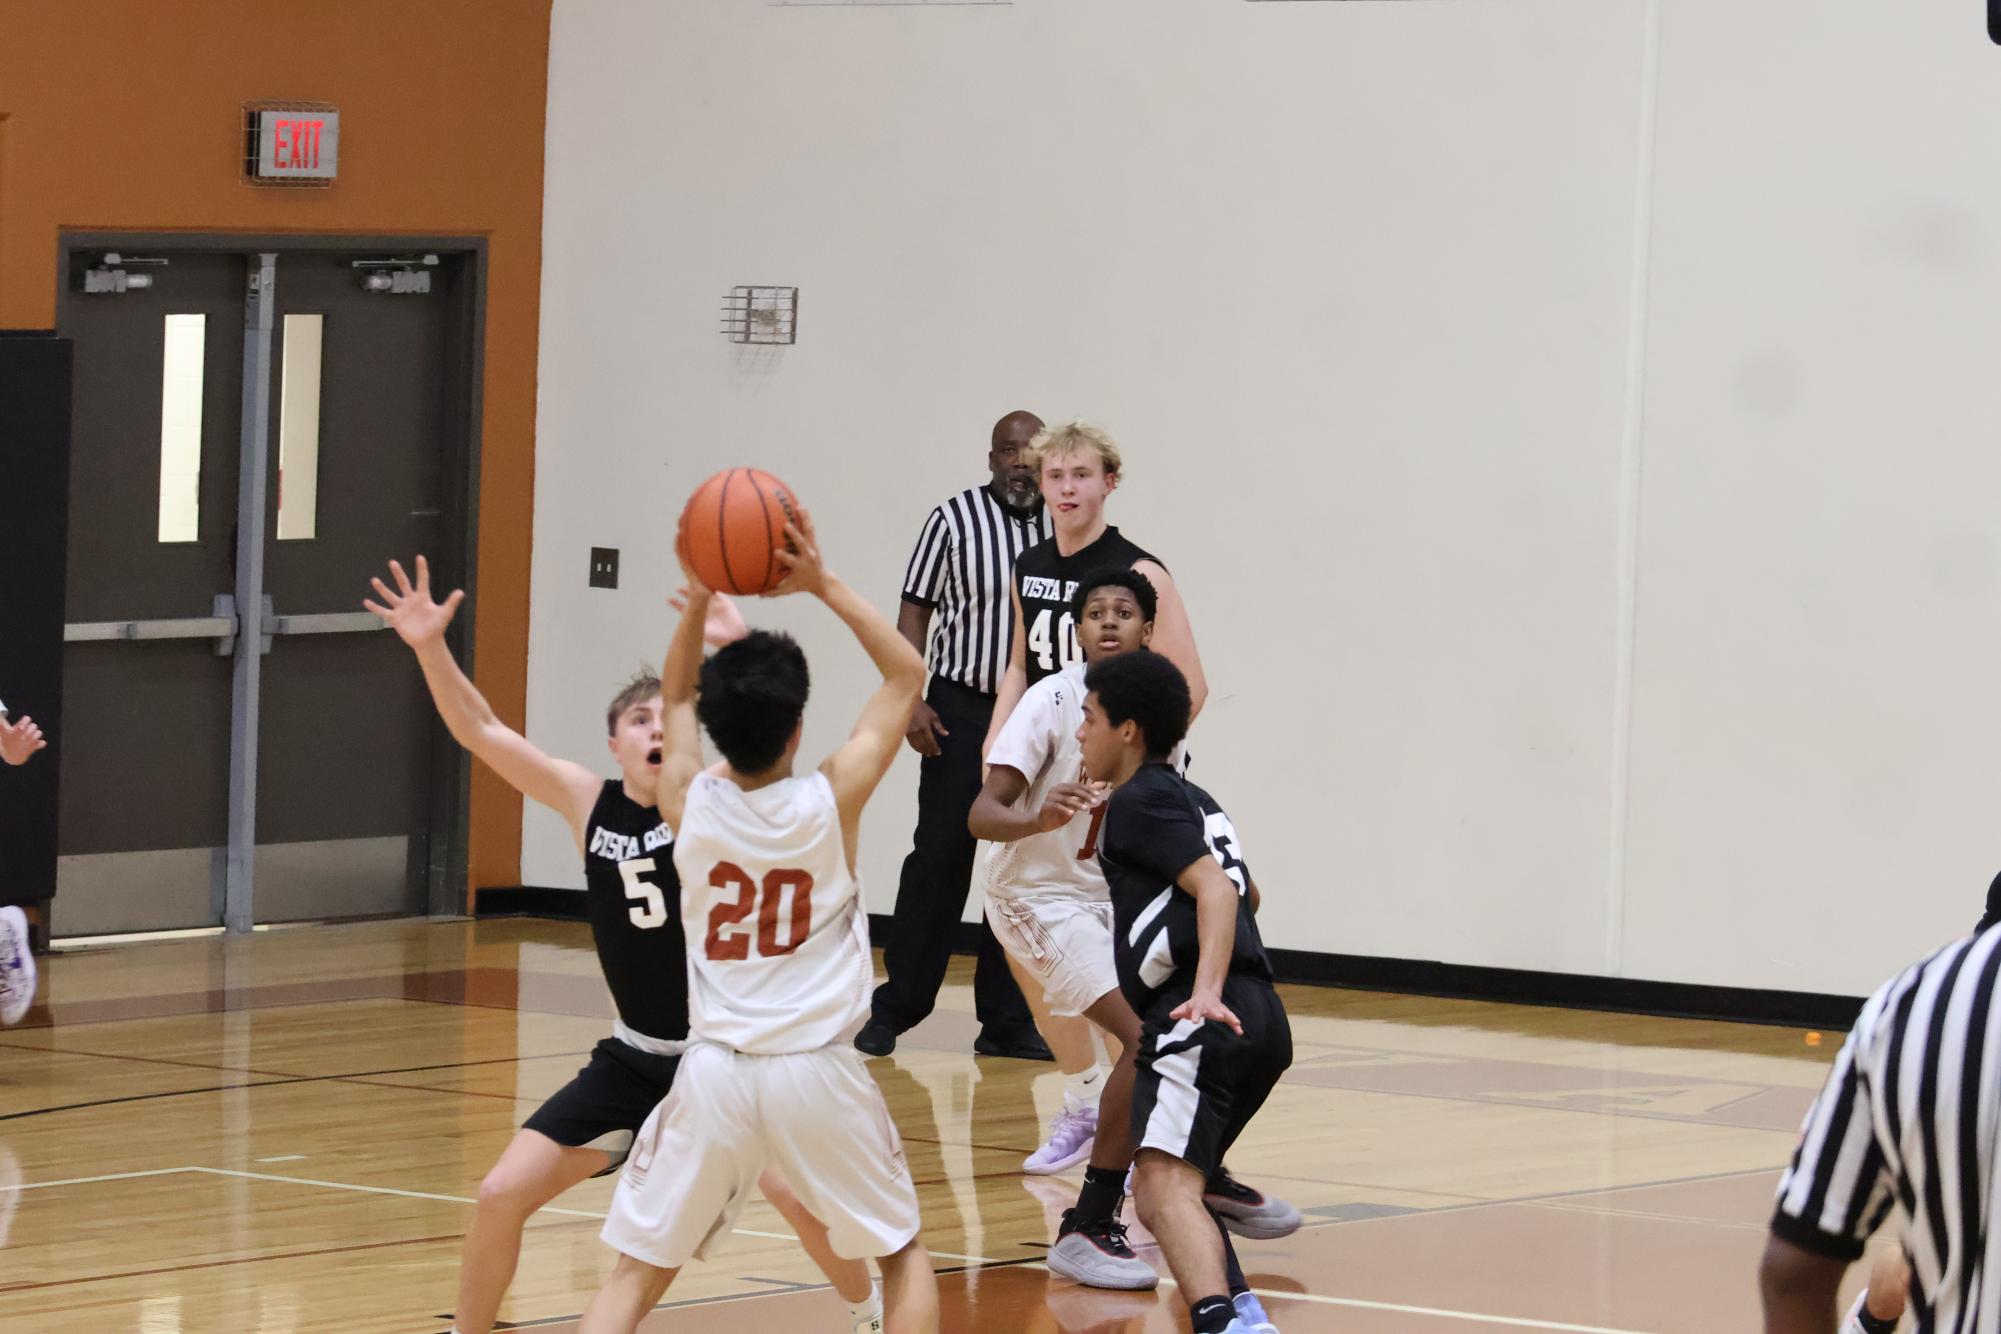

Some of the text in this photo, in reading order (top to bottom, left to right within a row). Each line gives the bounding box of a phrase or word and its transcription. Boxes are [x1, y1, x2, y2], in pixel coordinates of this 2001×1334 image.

[275, 120, 324, 168] EXIT
[1022, 576, 1060, 601] VISTA
[1028, 609, 1083, 670] 40
[589, 826, 640, 861] VISTA
[618, 858, 668, 929] 5
[704, 861, 814, 960] 20
